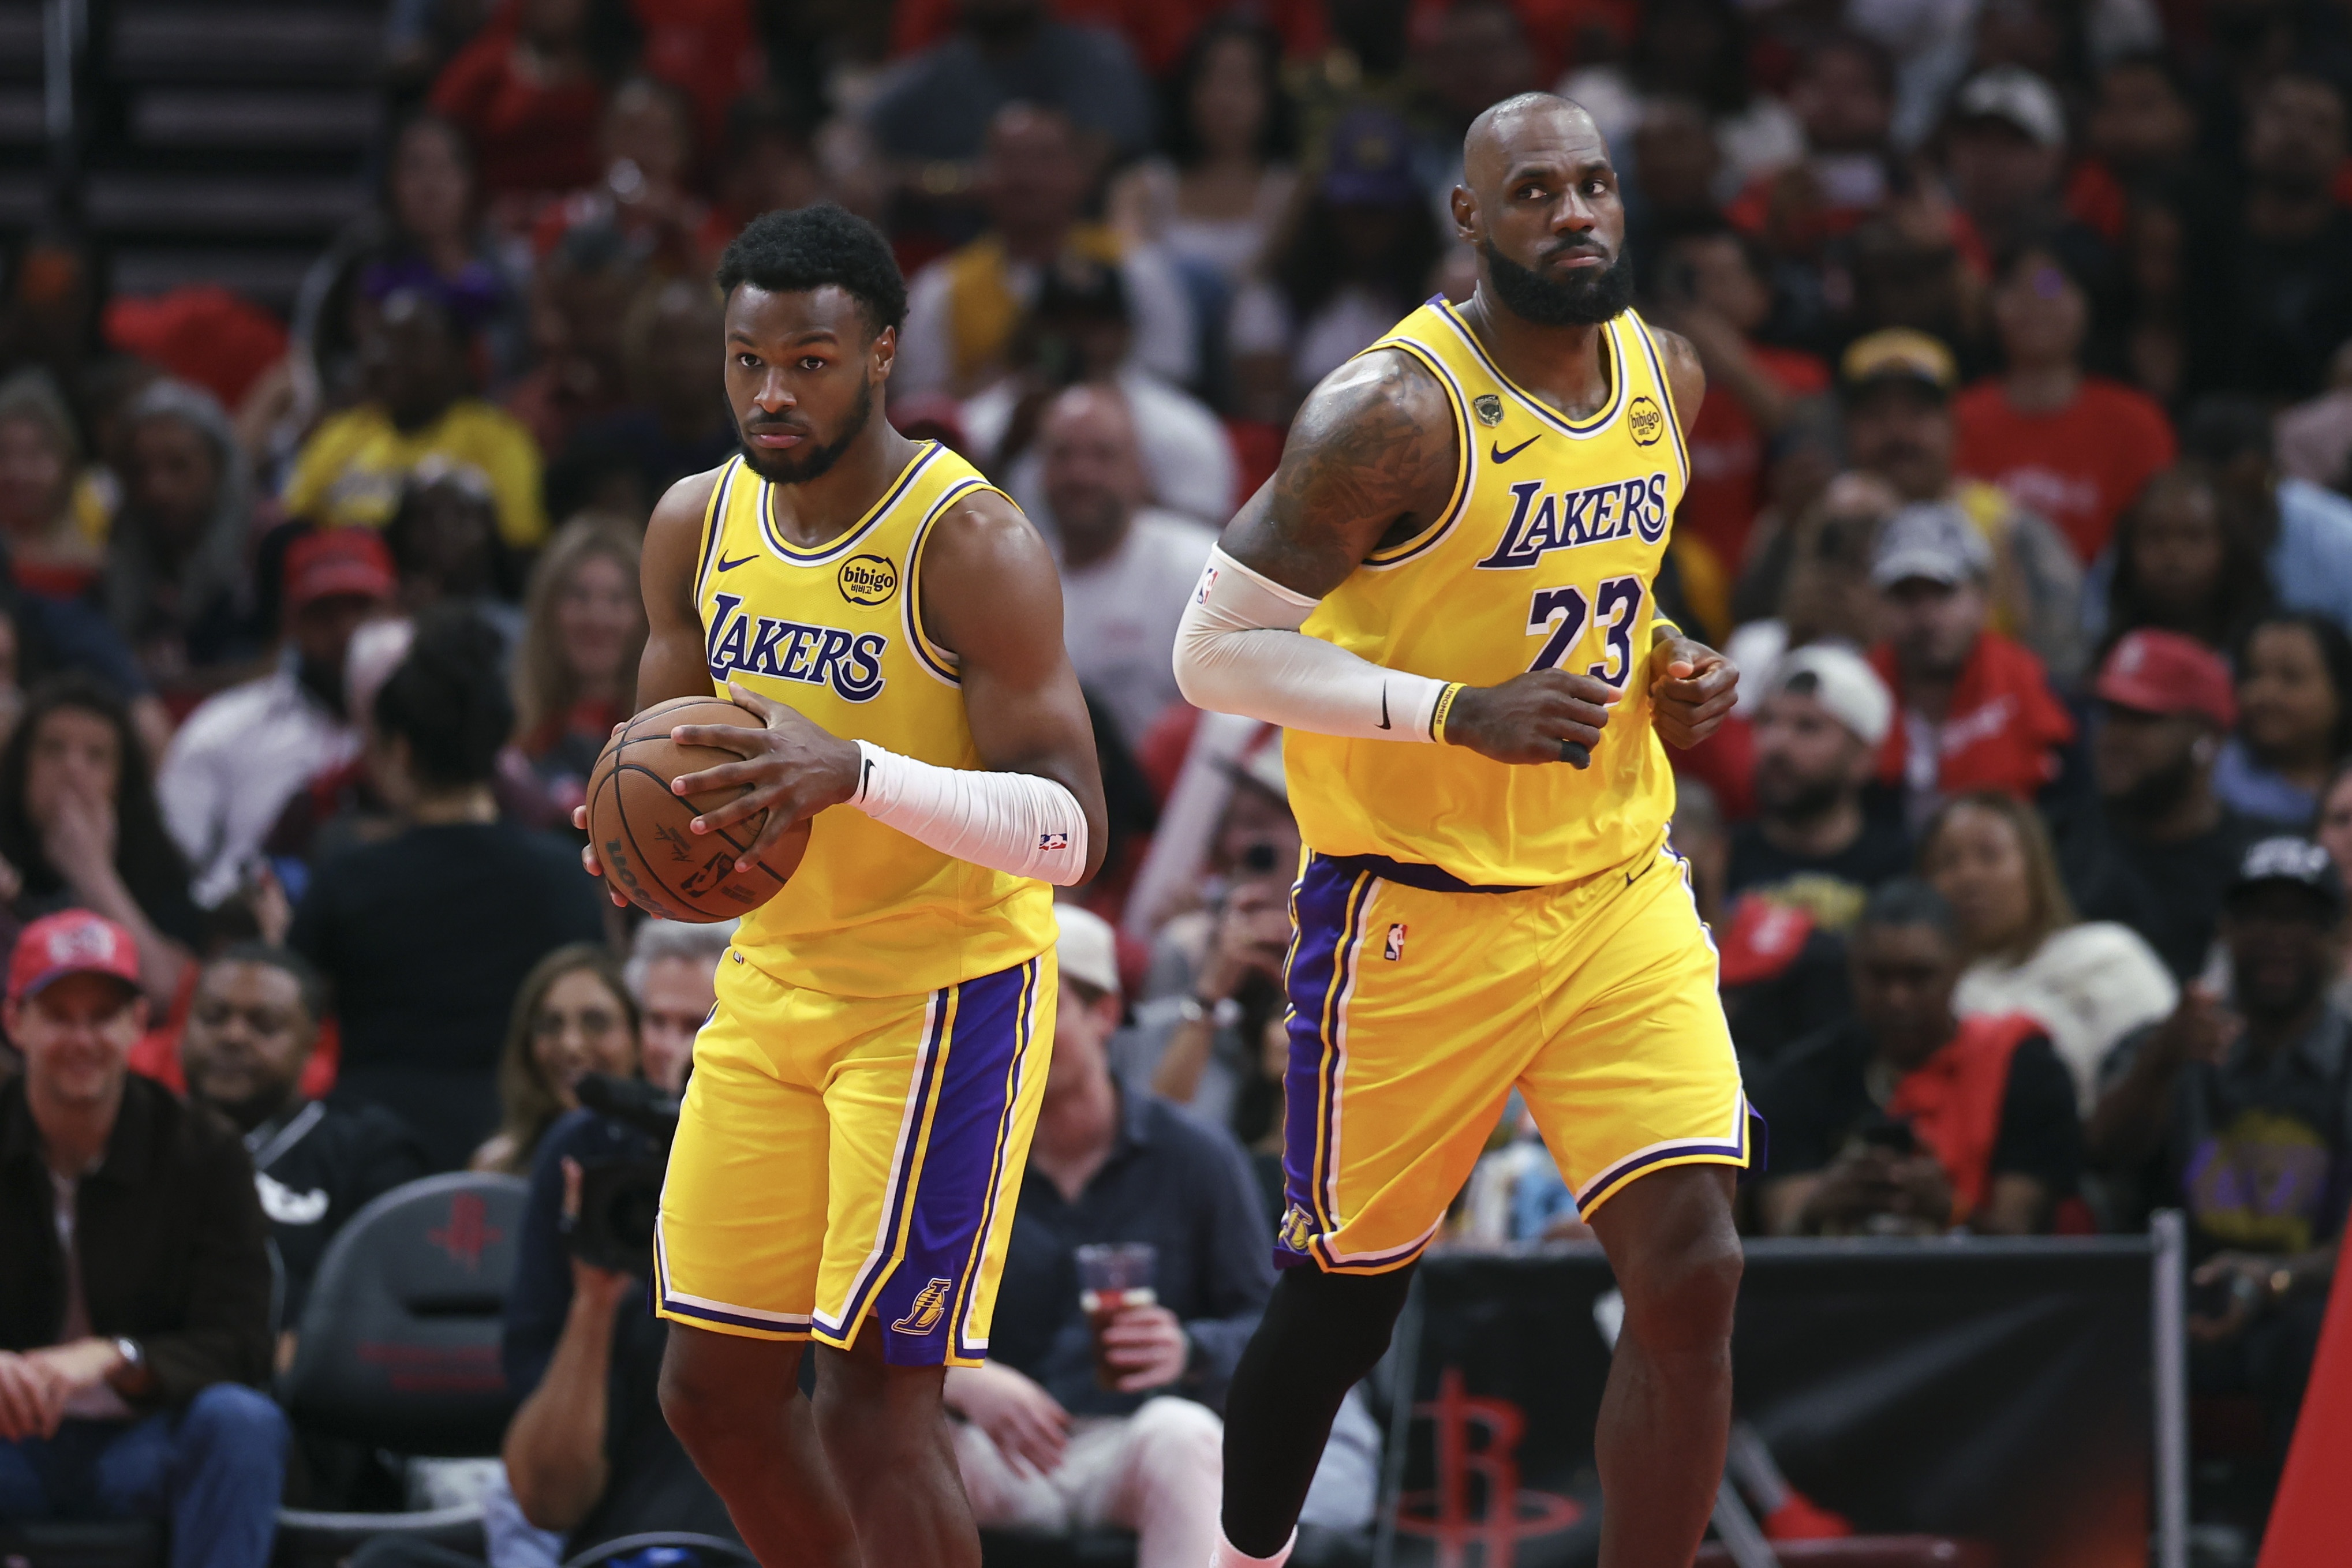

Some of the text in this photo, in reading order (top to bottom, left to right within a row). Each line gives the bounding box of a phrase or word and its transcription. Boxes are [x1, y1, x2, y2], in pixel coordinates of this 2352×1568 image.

[1630, 410, 1659, 430] bibigo
[1473, 471, 1669, 570] LAKERS
[844, 566, 894, 592] bibigo
[851, 583, 873, 594] 비비고
[705, 591, 889, 704] LAKERS
[1525, 574, 1646, 708] 23
[1436, 690, 1454, 725] PROMISE
